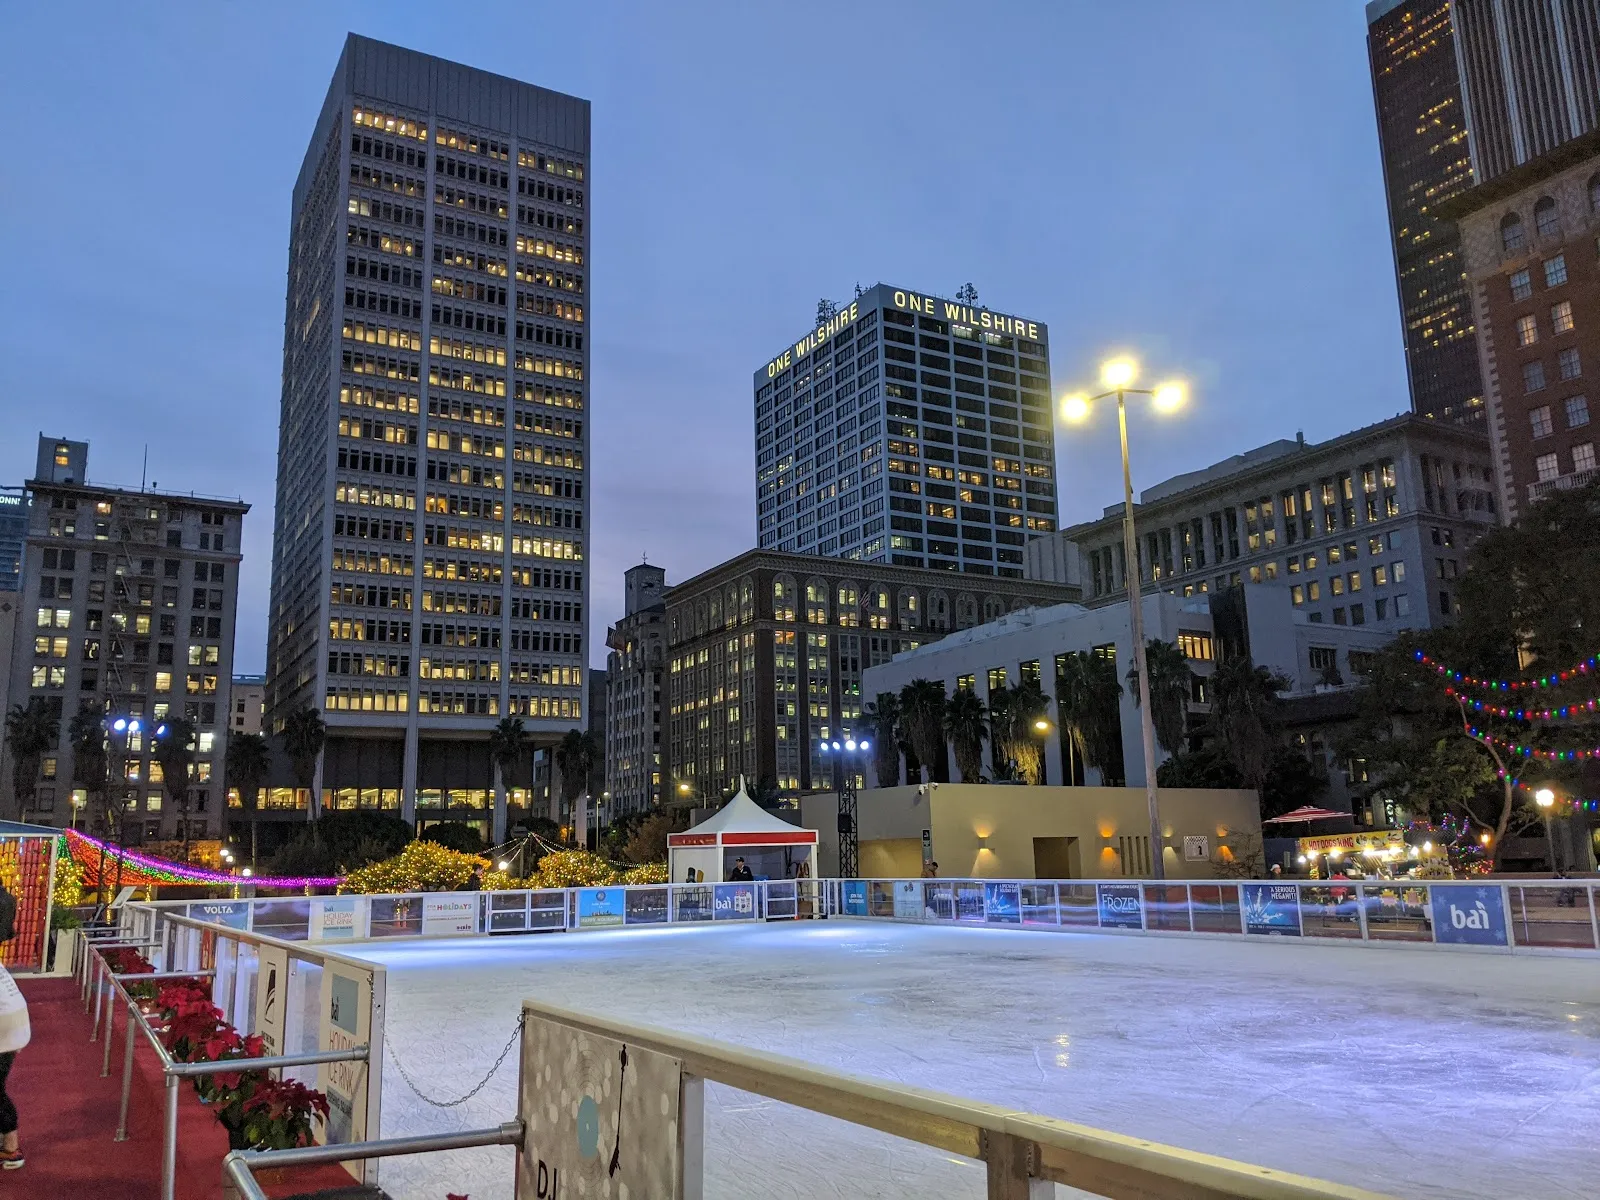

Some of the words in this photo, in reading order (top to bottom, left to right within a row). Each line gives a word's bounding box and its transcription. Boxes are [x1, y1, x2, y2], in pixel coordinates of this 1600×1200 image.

[894, 291, 935, 315] ONE
[944, 302, 1038, 340] WILSHIRE
[768, 350, 791, 378] ONE
[795, 302, 858, 358] WILSHIRE
[1309, 841, 1319, 850] HOT
[1337, 837, 1354, 847] KING
[203, 906, 234, 914] VOLTA
[1102, 893, 1141, 912] FROZEN
[1450, 900, 1490, 929] bai
[323, 912, 353, 920] HOLIDAY
[537, 1159, 558, 1200] DJ
